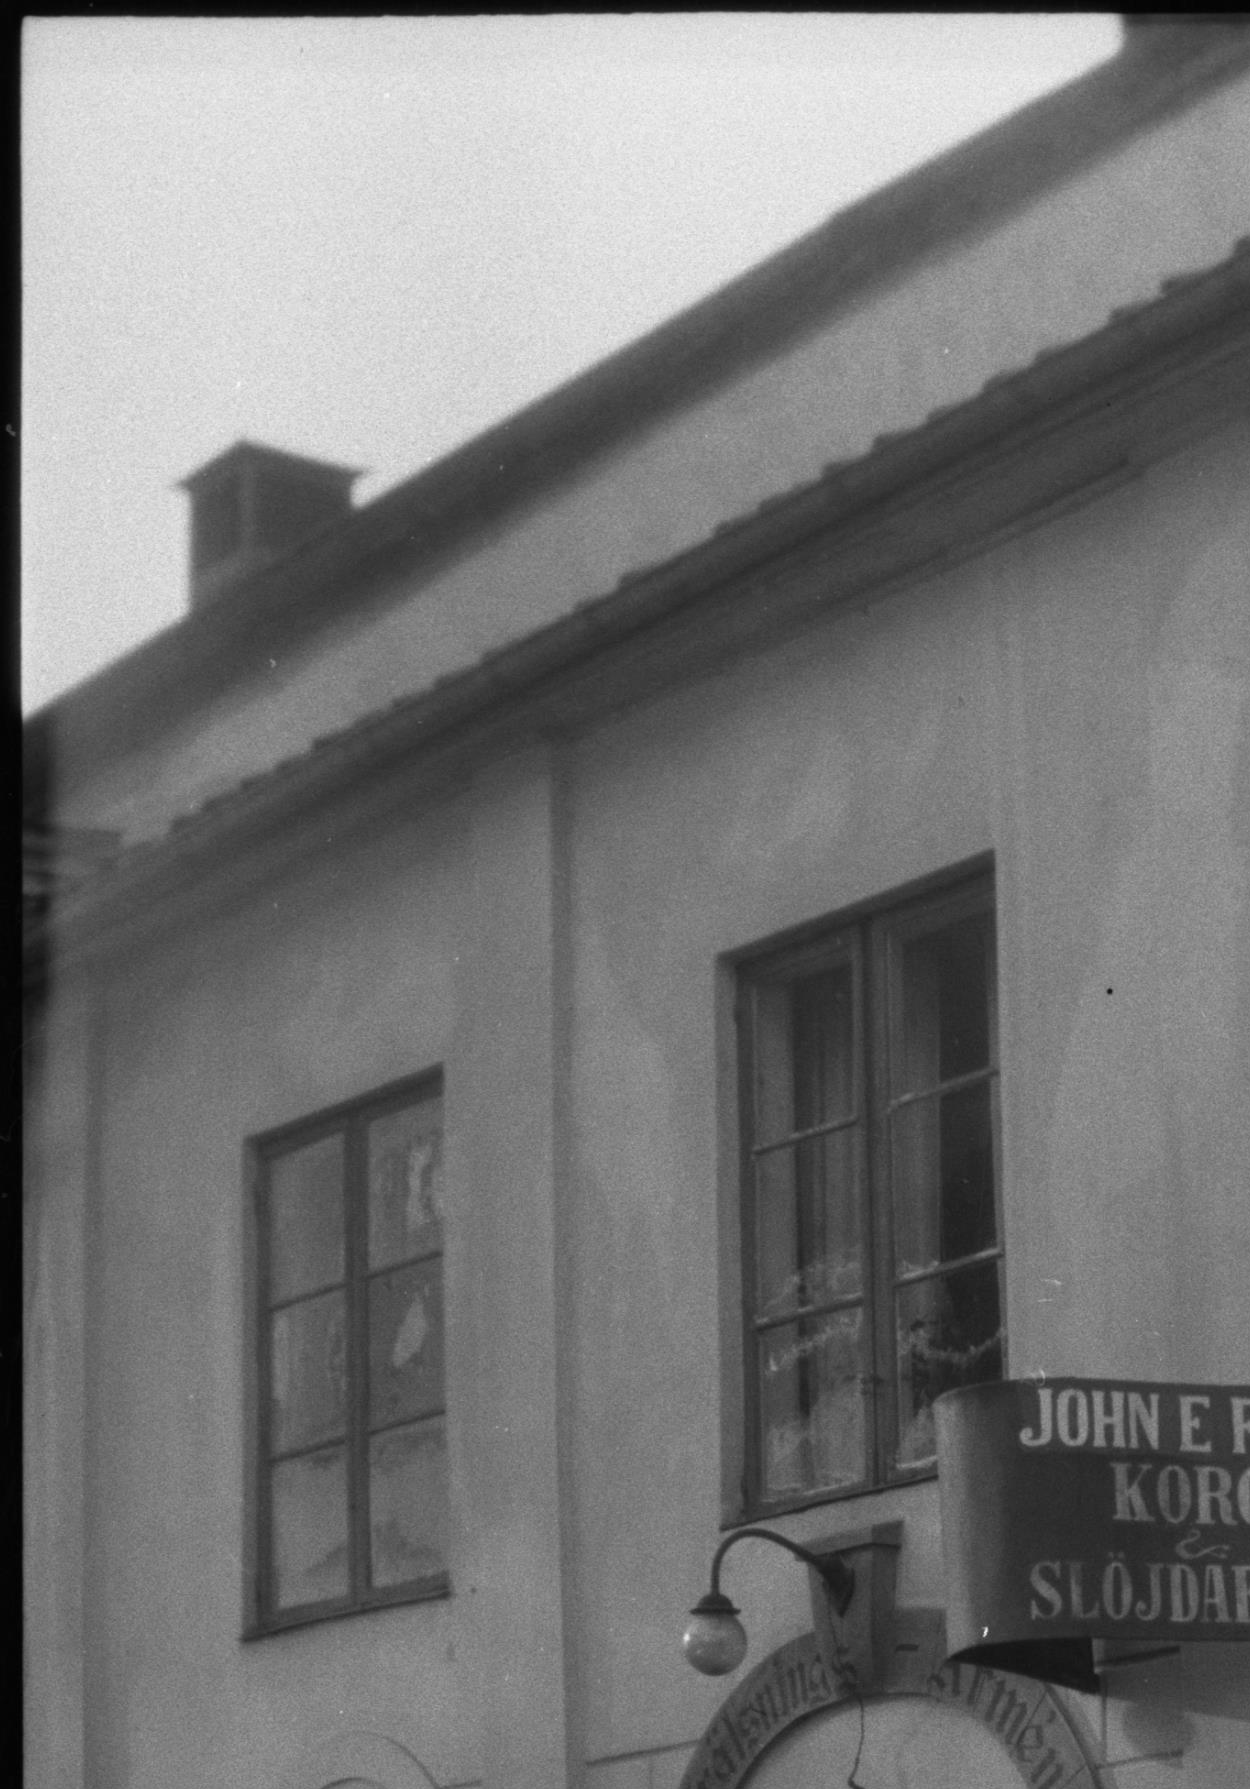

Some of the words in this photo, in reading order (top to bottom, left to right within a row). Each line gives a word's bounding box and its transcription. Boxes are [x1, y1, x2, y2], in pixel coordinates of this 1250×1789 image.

[1018, 1386, 1160, 1450] JOHN
[1178, 1394, 1213, 1453] E
[1174, 1528, 1231, 1560] &
